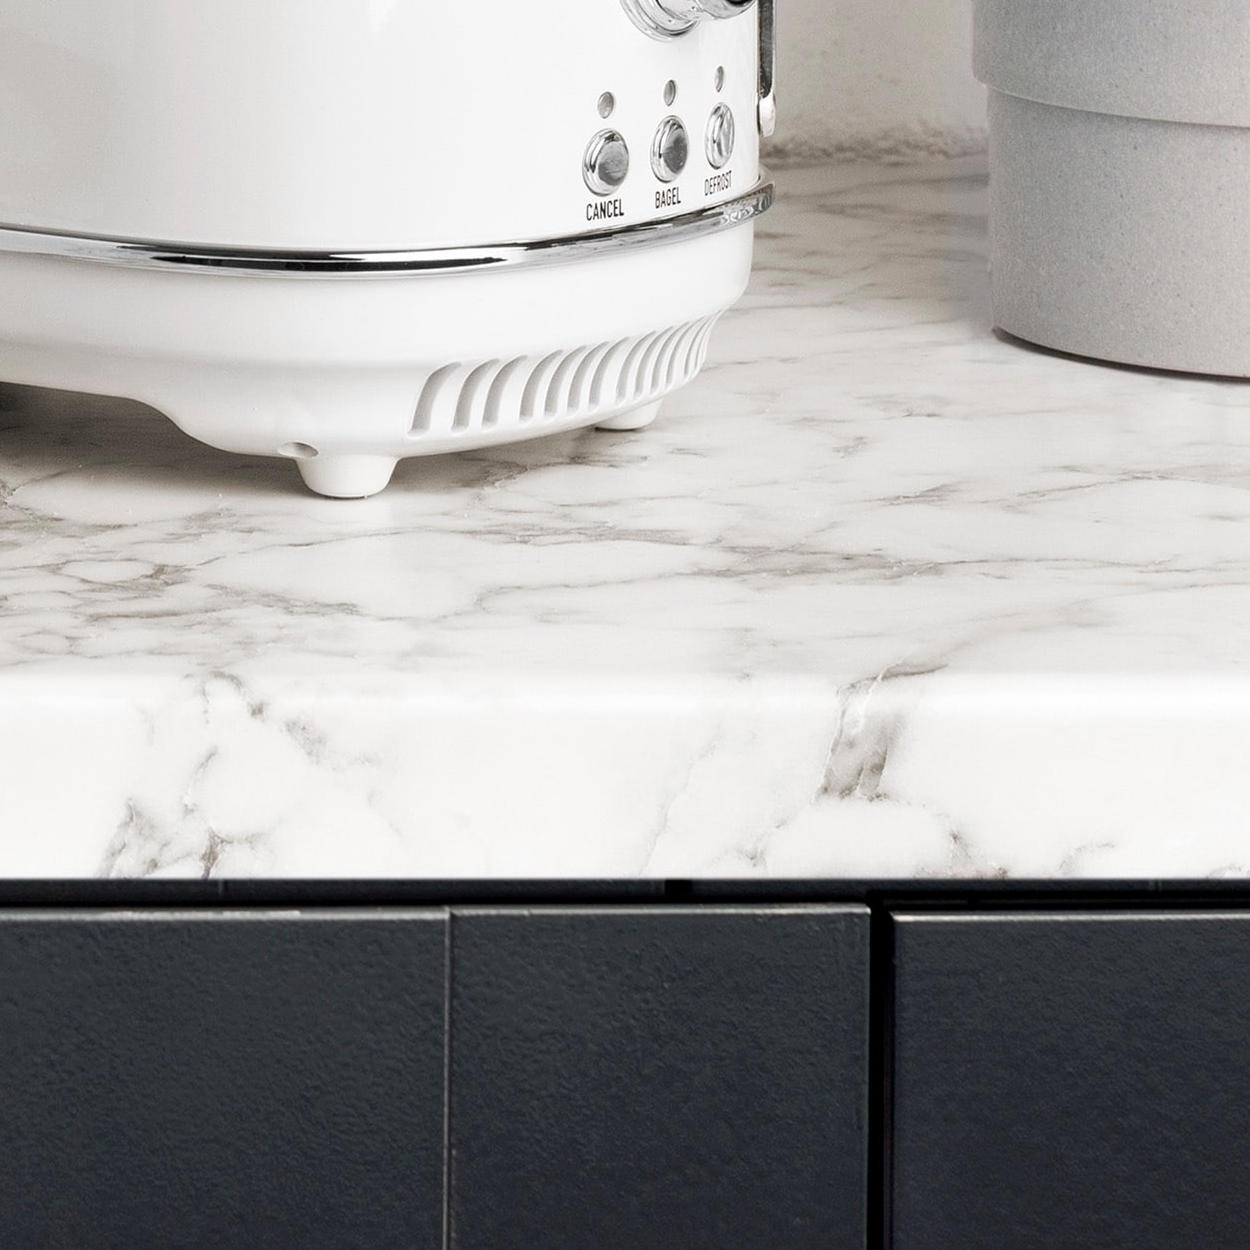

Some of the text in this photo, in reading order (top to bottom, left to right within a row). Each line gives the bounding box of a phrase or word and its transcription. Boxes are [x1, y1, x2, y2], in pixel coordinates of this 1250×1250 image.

[704, 170, 733, 196] DEFROST
[654, 186, 682, 209] BAGEL
[585, 198, 625, 222] CANCEL
